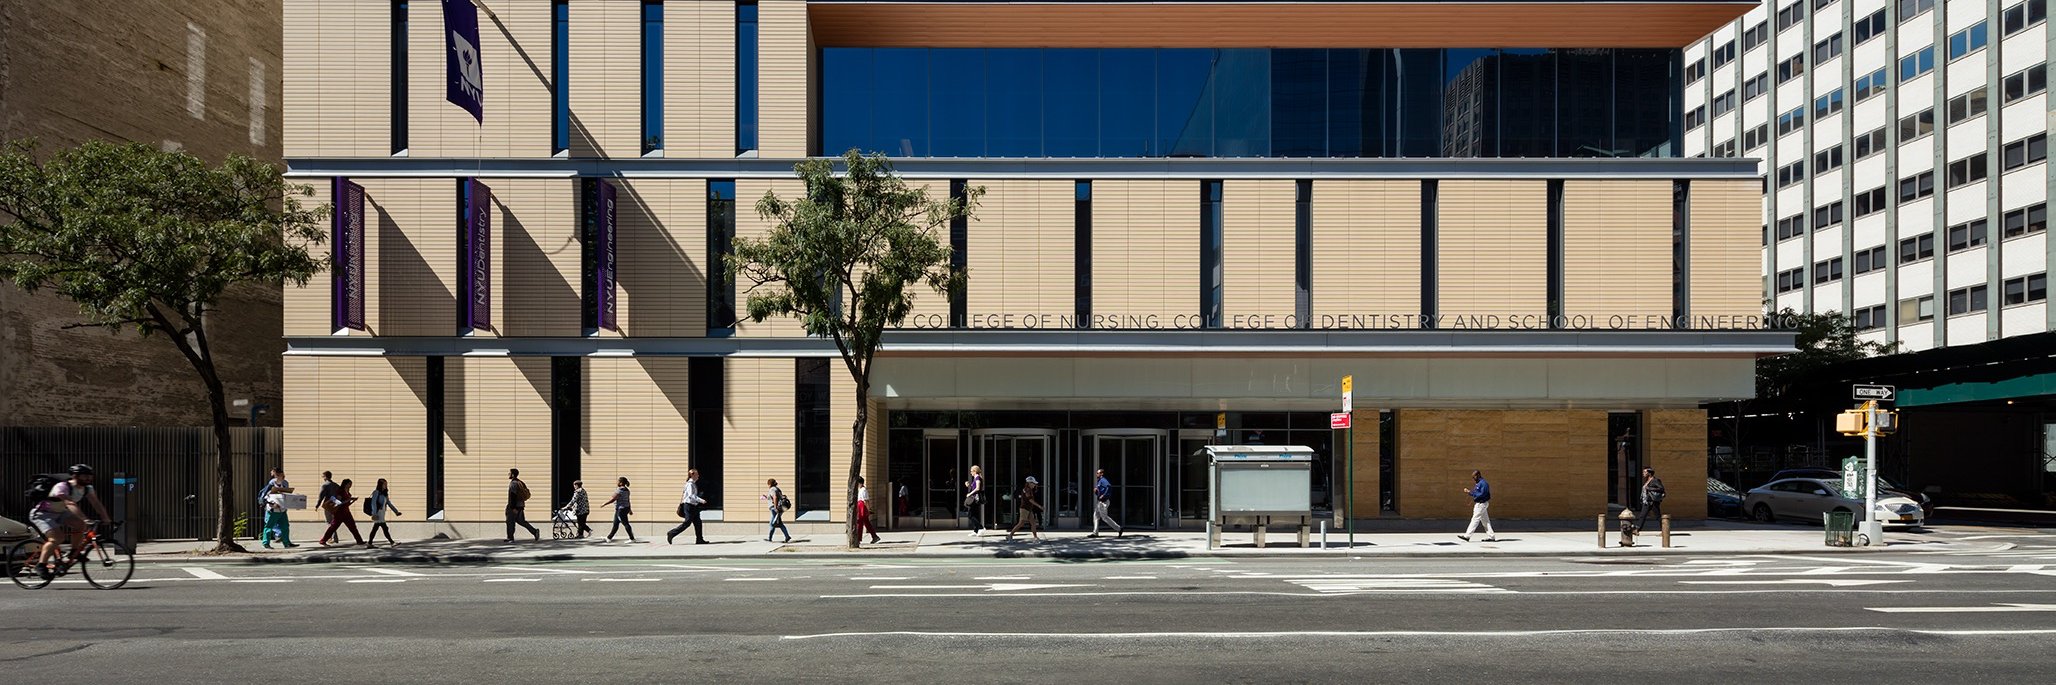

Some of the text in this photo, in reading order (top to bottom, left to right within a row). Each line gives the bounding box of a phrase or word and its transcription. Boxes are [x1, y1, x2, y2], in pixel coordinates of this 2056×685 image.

[477, 206, 487, 305] NYUDentistry
[606, 198, 615, 314] NYUEngineering
[913, 314, 1015, 329] COLLEGE
[1023, 314, 1052, 329] OF
[1060, 314, 1165, 331] NURSING,
[1174, 314, 1276, 329] COLLEGE
[1321, 314, 1445, 329] DENTISTRY
[1453, 314, 1500, 329] AND
[1508, 314, 1600, 329] SCHOOL
[1609, 315, 1638, 329] OF
[1646, 315, 1799, 330] ENGINEERING
